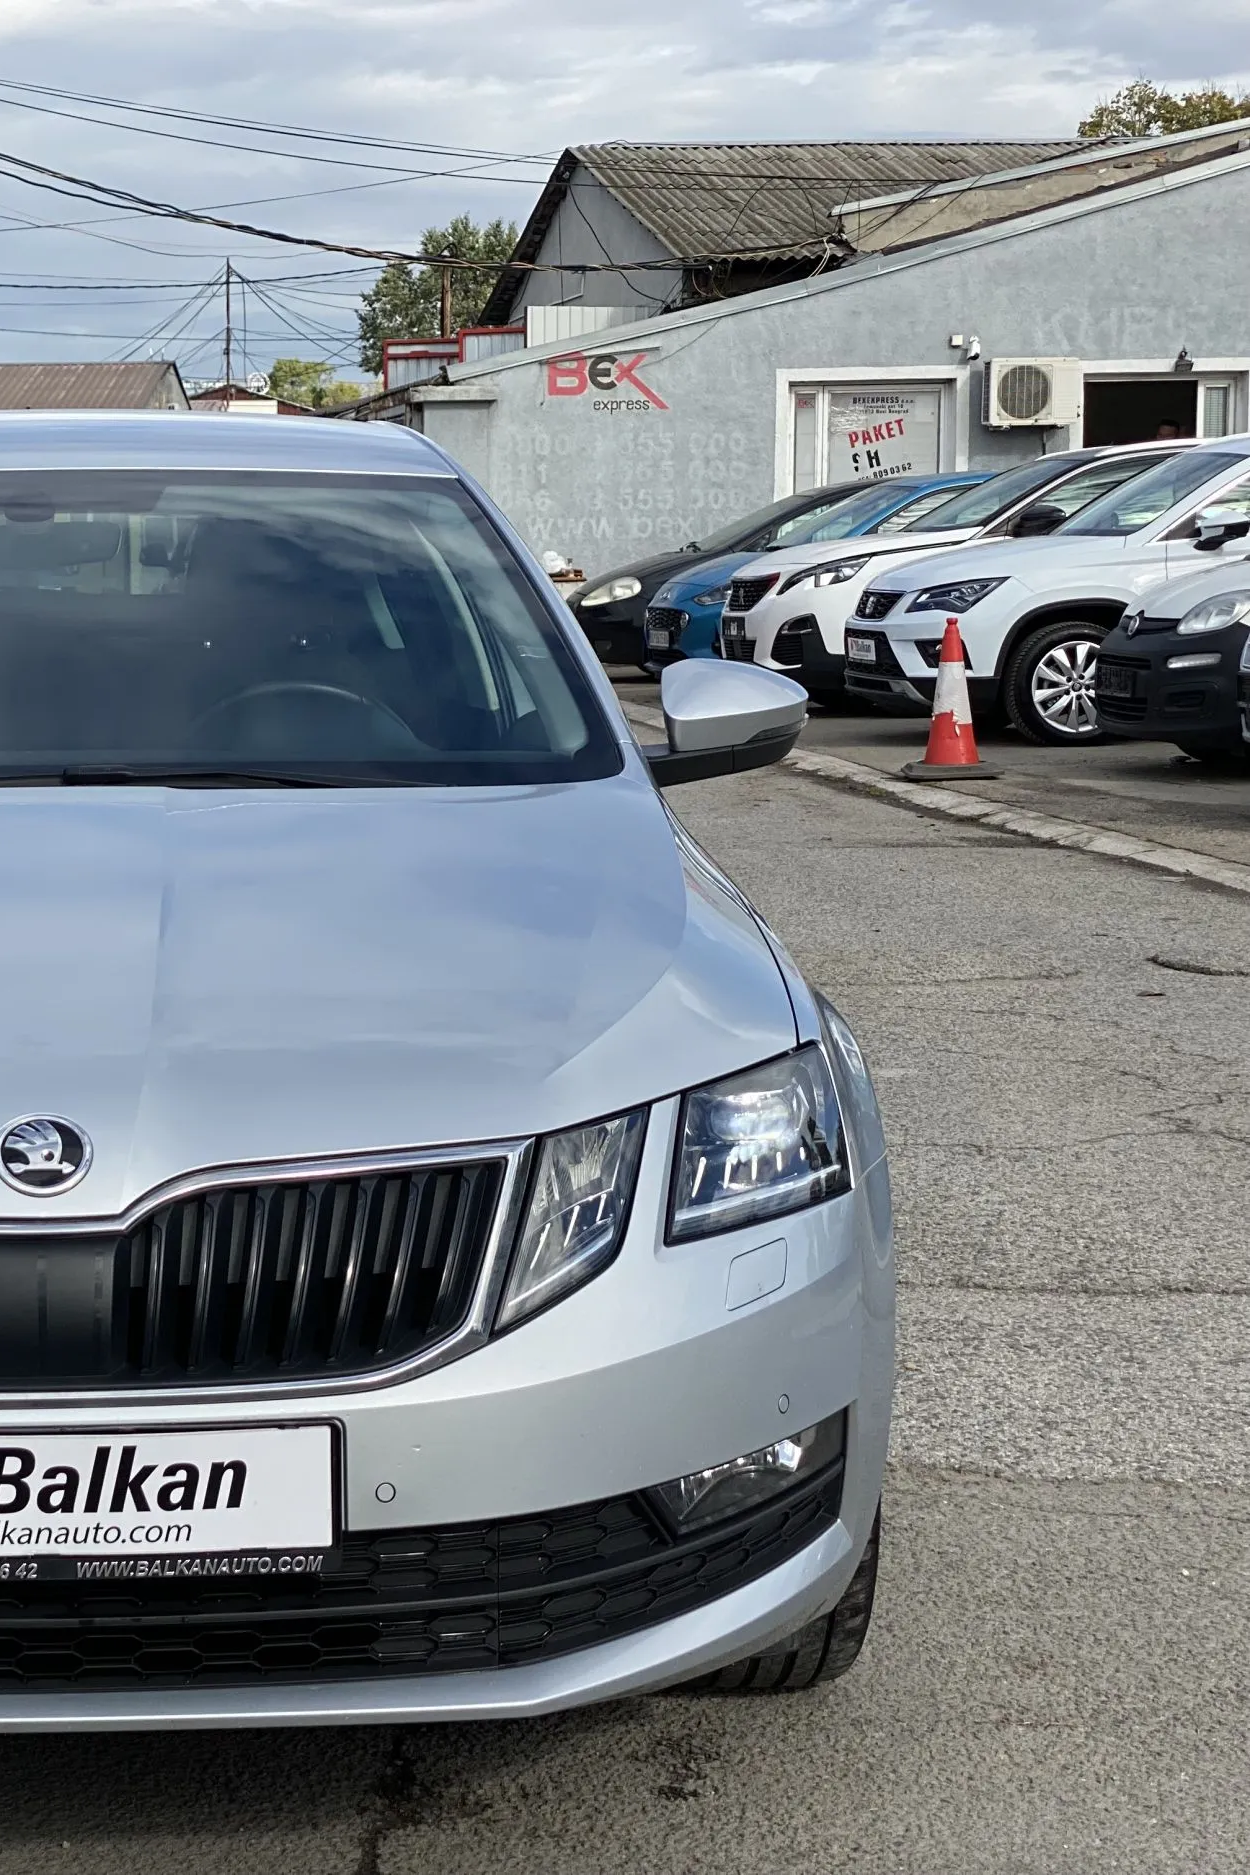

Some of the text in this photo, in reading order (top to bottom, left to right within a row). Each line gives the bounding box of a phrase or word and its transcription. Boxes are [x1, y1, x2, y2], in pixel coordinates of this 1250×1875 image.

[593, 398, 651, 414] express
[848, 418, 904, 448] PAKET
[890, 465, 900, 475] 03
[901, 462, 912, 472] 62
[15, 1562, 38, 1580] 42
[76, 1555, 324, 1578] WWW.BALKANAUTO.COM
